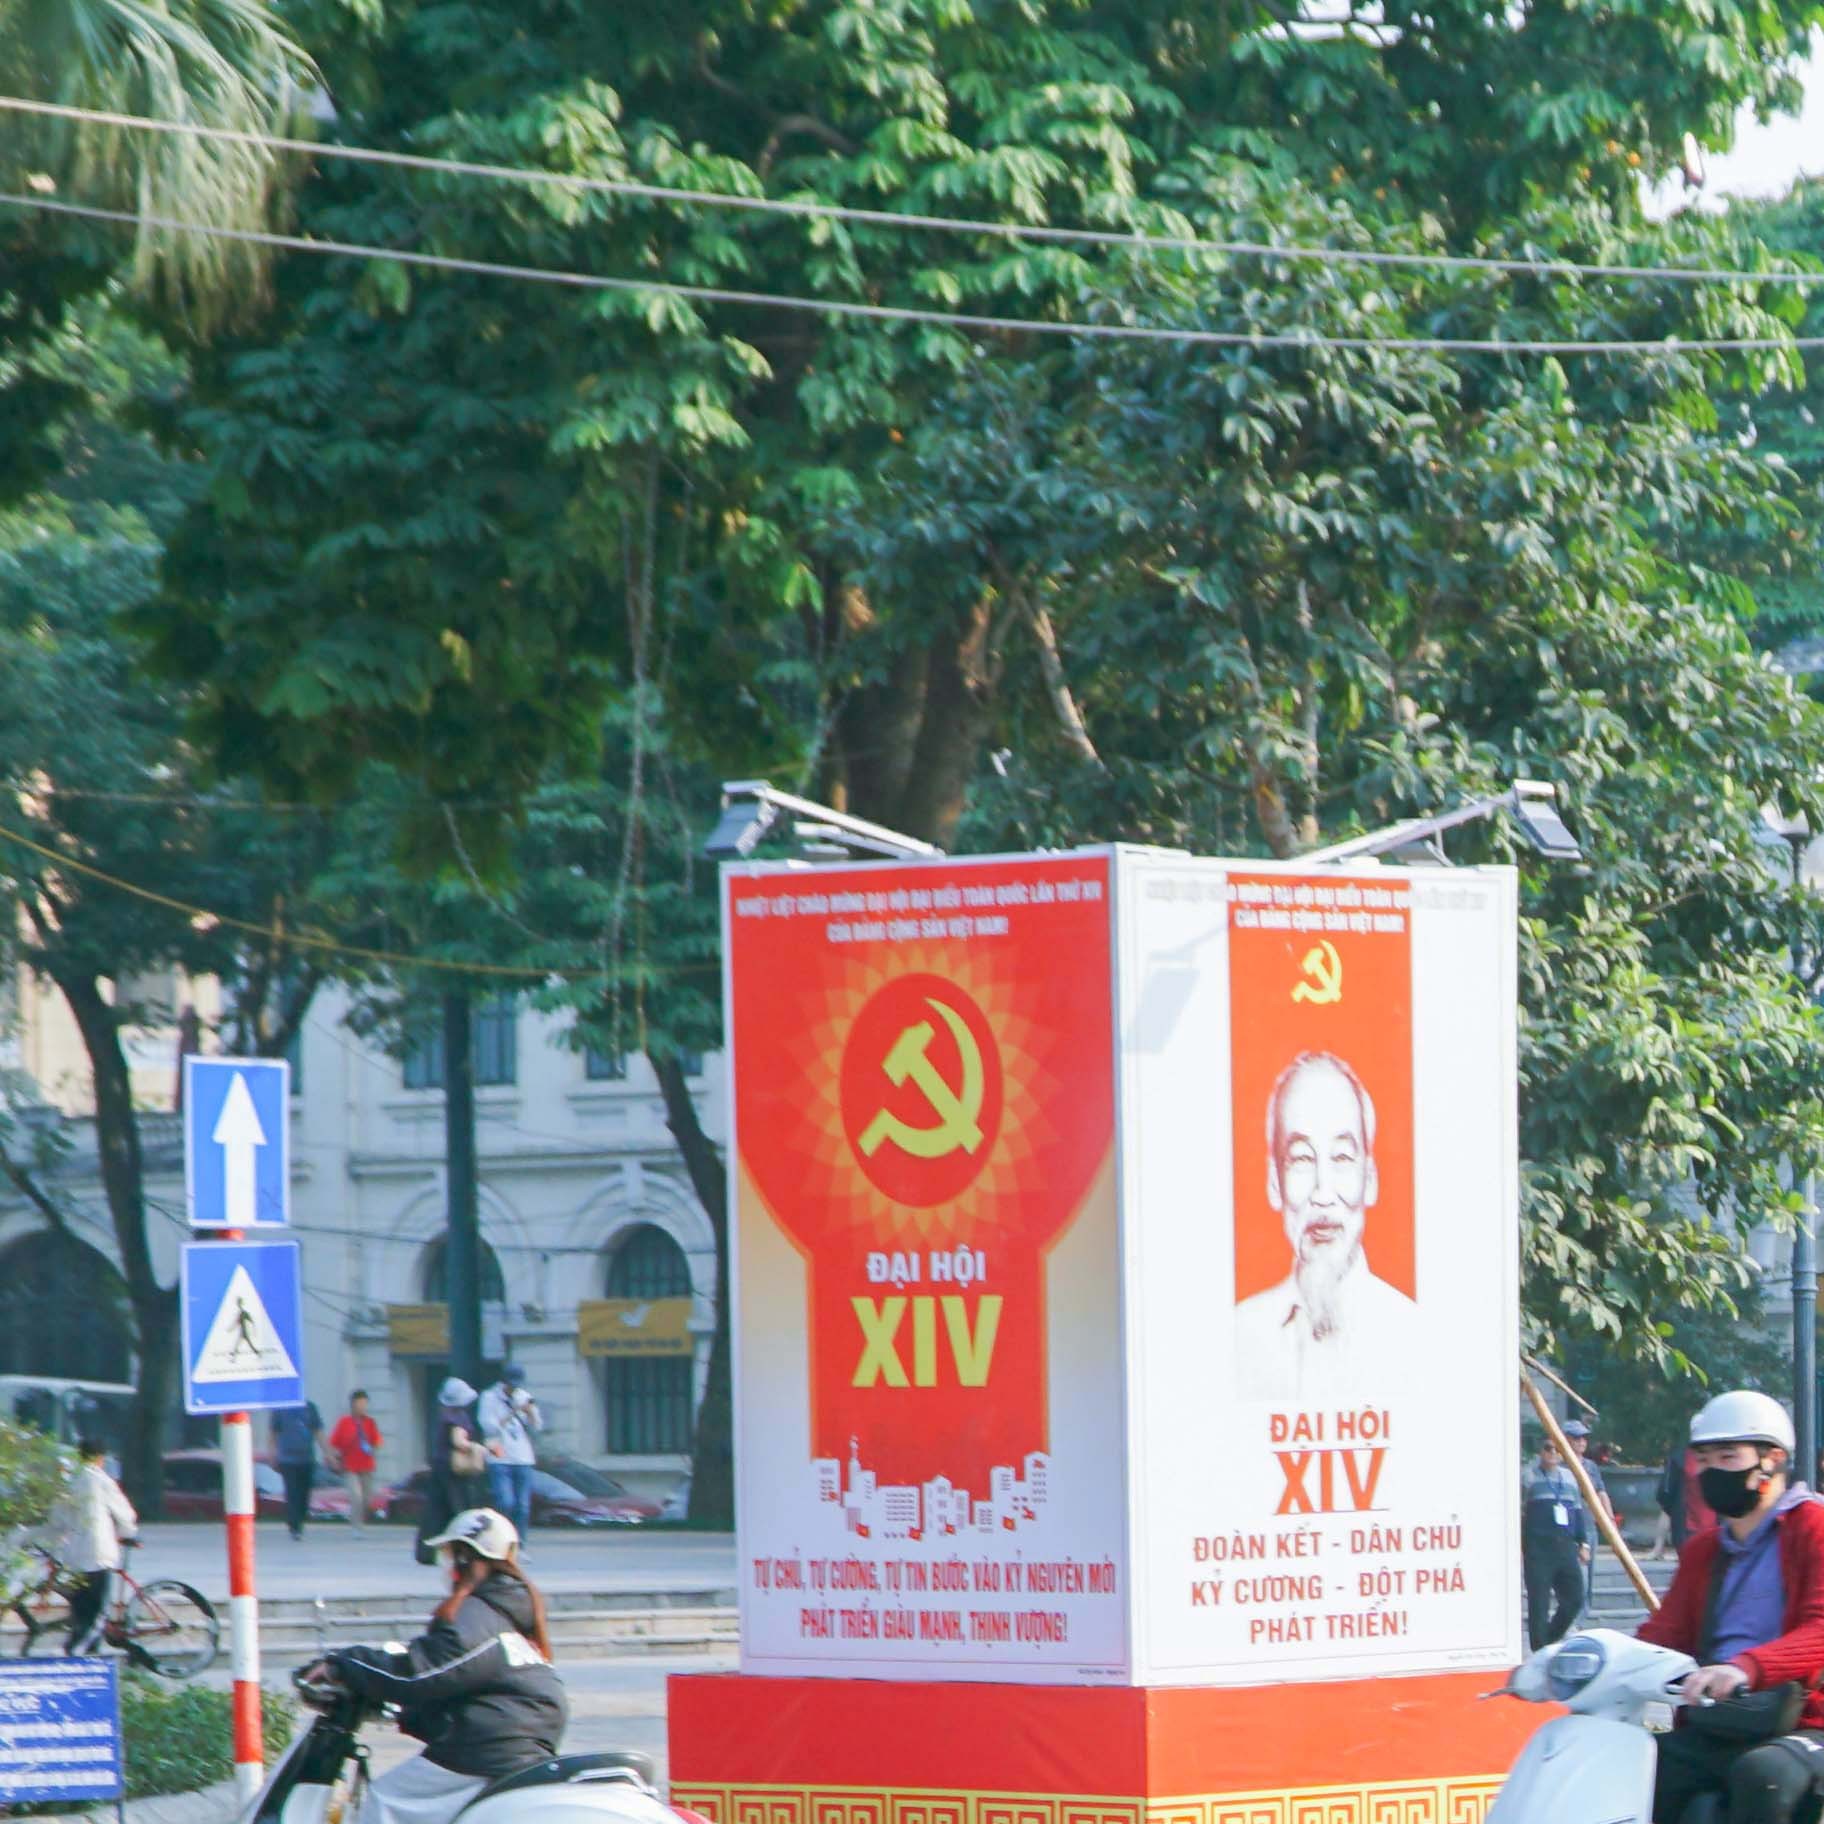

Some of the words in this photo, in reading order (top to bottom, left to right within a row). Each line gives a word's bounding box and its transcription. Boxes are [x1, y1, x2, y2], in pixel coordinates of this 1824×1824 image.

[866, 1251, 921, 1289] ĐẠI
[929, 1243, 987, 1288] HỘI
[850, 1295, 1004, 1388] XIV
[1270, 1412, 1324, 1449] ĐẠI
[1336, 1404, 1390, 1446] HỘI
[1273, 1447, 1388, 1515] XIV
[1193, 1529, 1266, 1562] ĐOÀN
[1276, 1521, 1323, 1558] KẾT
[1350, 1522, 1403, 1554] DÂN
[1413, 1513, 1462, 1551] CHỦ
[754, 1557, 773, 1595] TỰ
[809, 1557, 827, 1597] TỰ
[884, 1558, 902, 1597] TỰ
[905, 1560, 928, 1591] TIN
[932, 1552, 968, 1592] BƯỚC
[972, 1554, 1000, 1593] VÀO
[1005, 1549, 1023, 1593] KỶ
[1027, 1556, 1084, 1594] NGUYÊN
[1088, 1552, 1116, 1594] MỚI
[1191, 1567, 1225, 1606] KỶ
[1233, 1574, 1323, 1605] CƯƠNG
[1359, 1565, 1406, 1602] ĐỘT
[1415, 1561, 1465, 1594] PHÁ
[801, 1602, 835, 1639] PHÁT
[838, 1595, 879, 1640] TRIỂN
[883, 1602, 914, 1641] GIÀU
[969, 1610, 1011, 1649] THỊNH
[1014, 1609, 1069, 1650] VƯỢNG!
[1250, 1611, 1316, 1645] PHÁT
[1325, 1598, 1409, 1640] TRIỂN!
